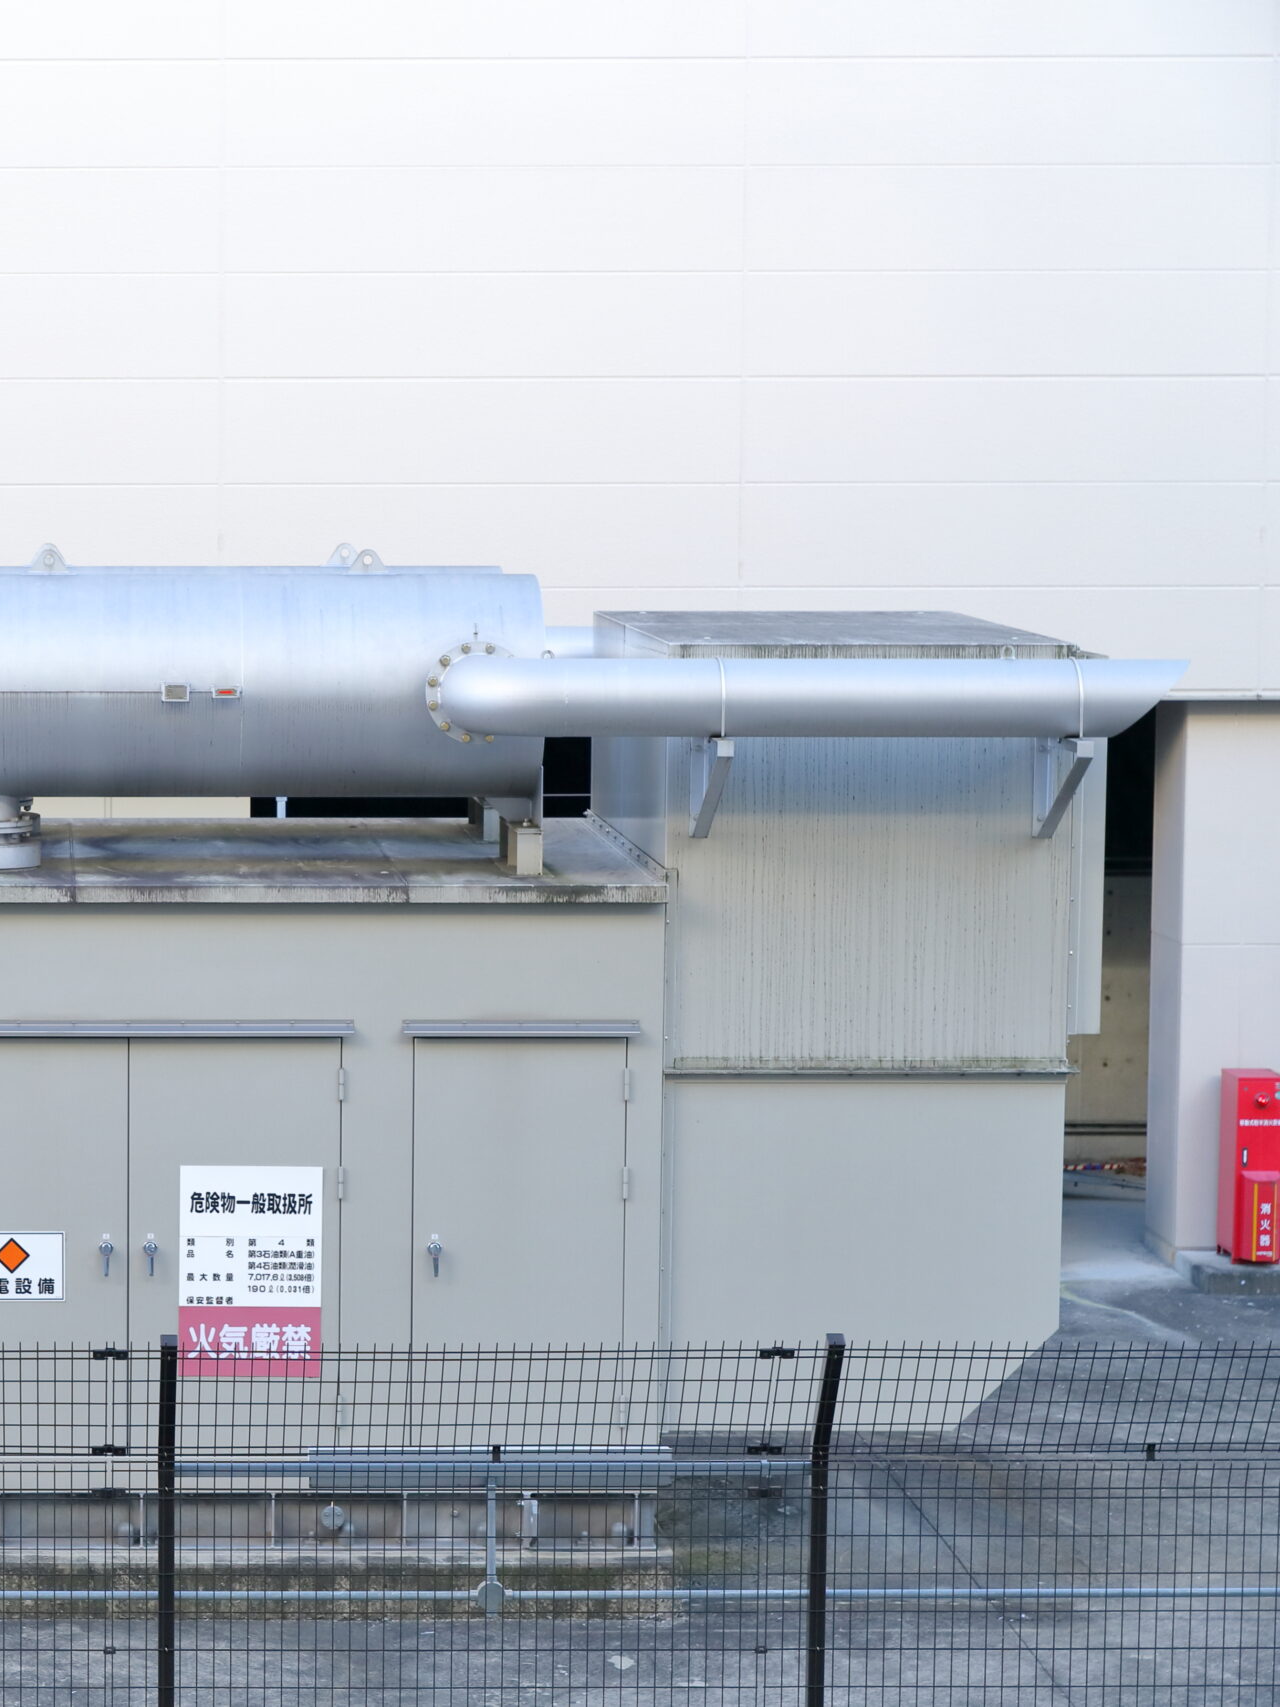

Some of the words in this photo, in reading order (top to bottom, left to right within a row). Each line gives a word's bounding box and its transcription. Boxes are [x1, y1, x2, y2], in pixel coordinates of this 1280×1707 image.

[190, 1191, 313, 1215] 危険物一般取扱所
[186, 1296, 234, 1305] 保安監督者
[187, 1323, 312, 1359] 火気厳禁
